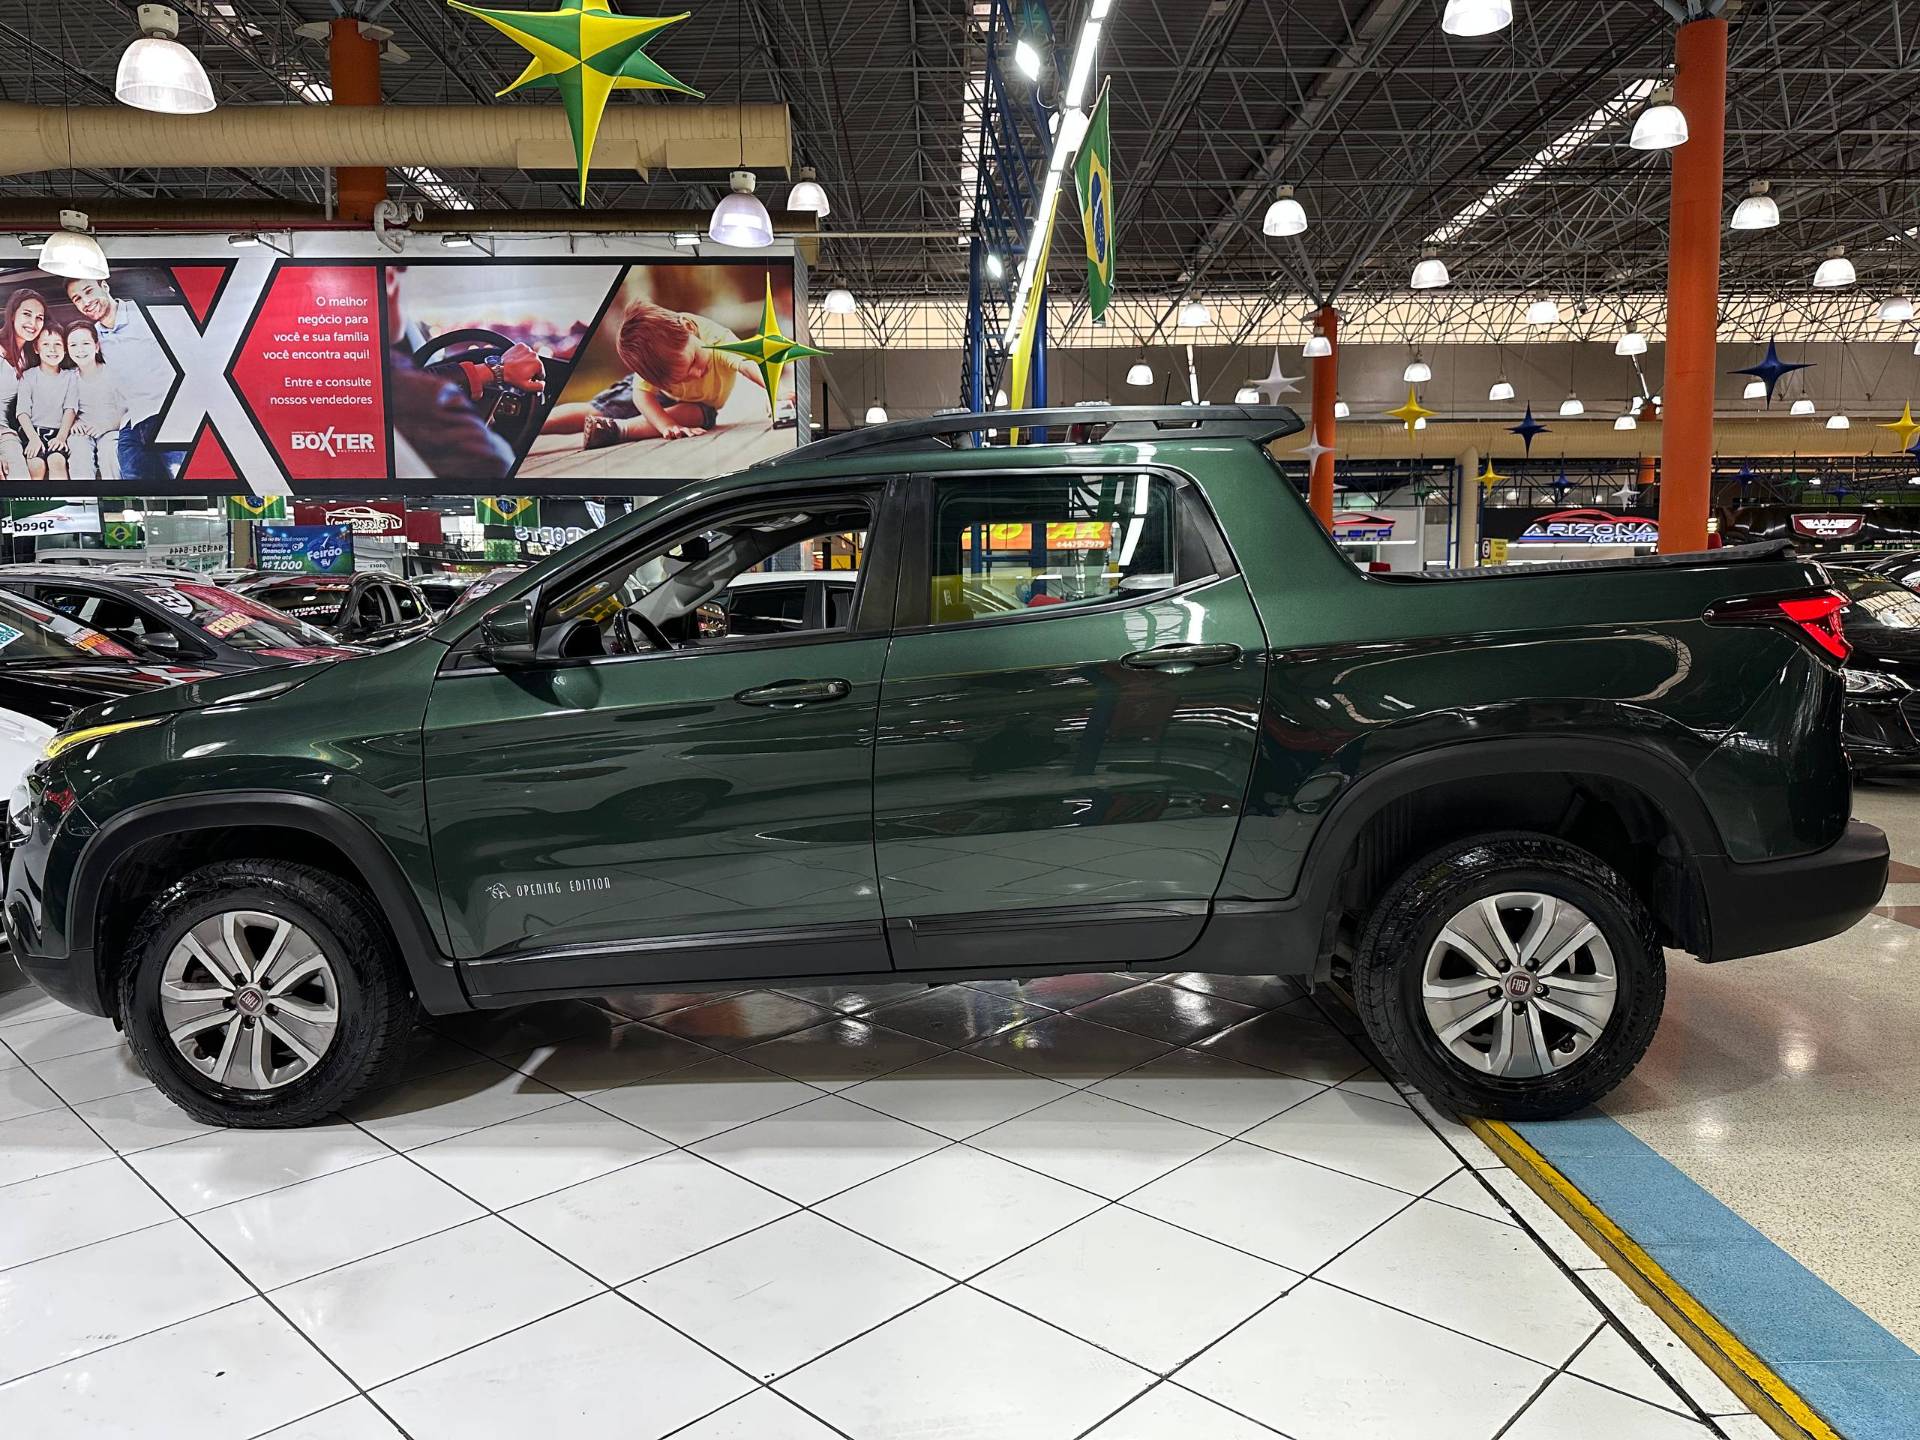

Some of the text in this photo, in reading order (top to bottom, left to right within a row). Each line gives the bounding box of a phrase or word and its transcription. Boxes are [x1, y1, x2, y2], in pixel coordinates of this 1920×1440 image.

[316, 296, 368, 307] O melhor
[298, 314, 369, 326] negócio para
[274, 331, 370, 342] você e sua família
[263, 349, 370, 361] você encontra aqui!
[284, 377, 372, 387] Entre e consulte
[270, 394, 373, 405] nossos vendedores
[291, 426, 375, 458] BOXTER
[1522, 522, 1659, 537] ARIZONA
[306, 547, 342, 561] Feirão
[273, 561, 303, 570] 1.000
[516, 876, 611, 897] OPENING EDITION
[1511, 978, 1528, 992] FIAT
